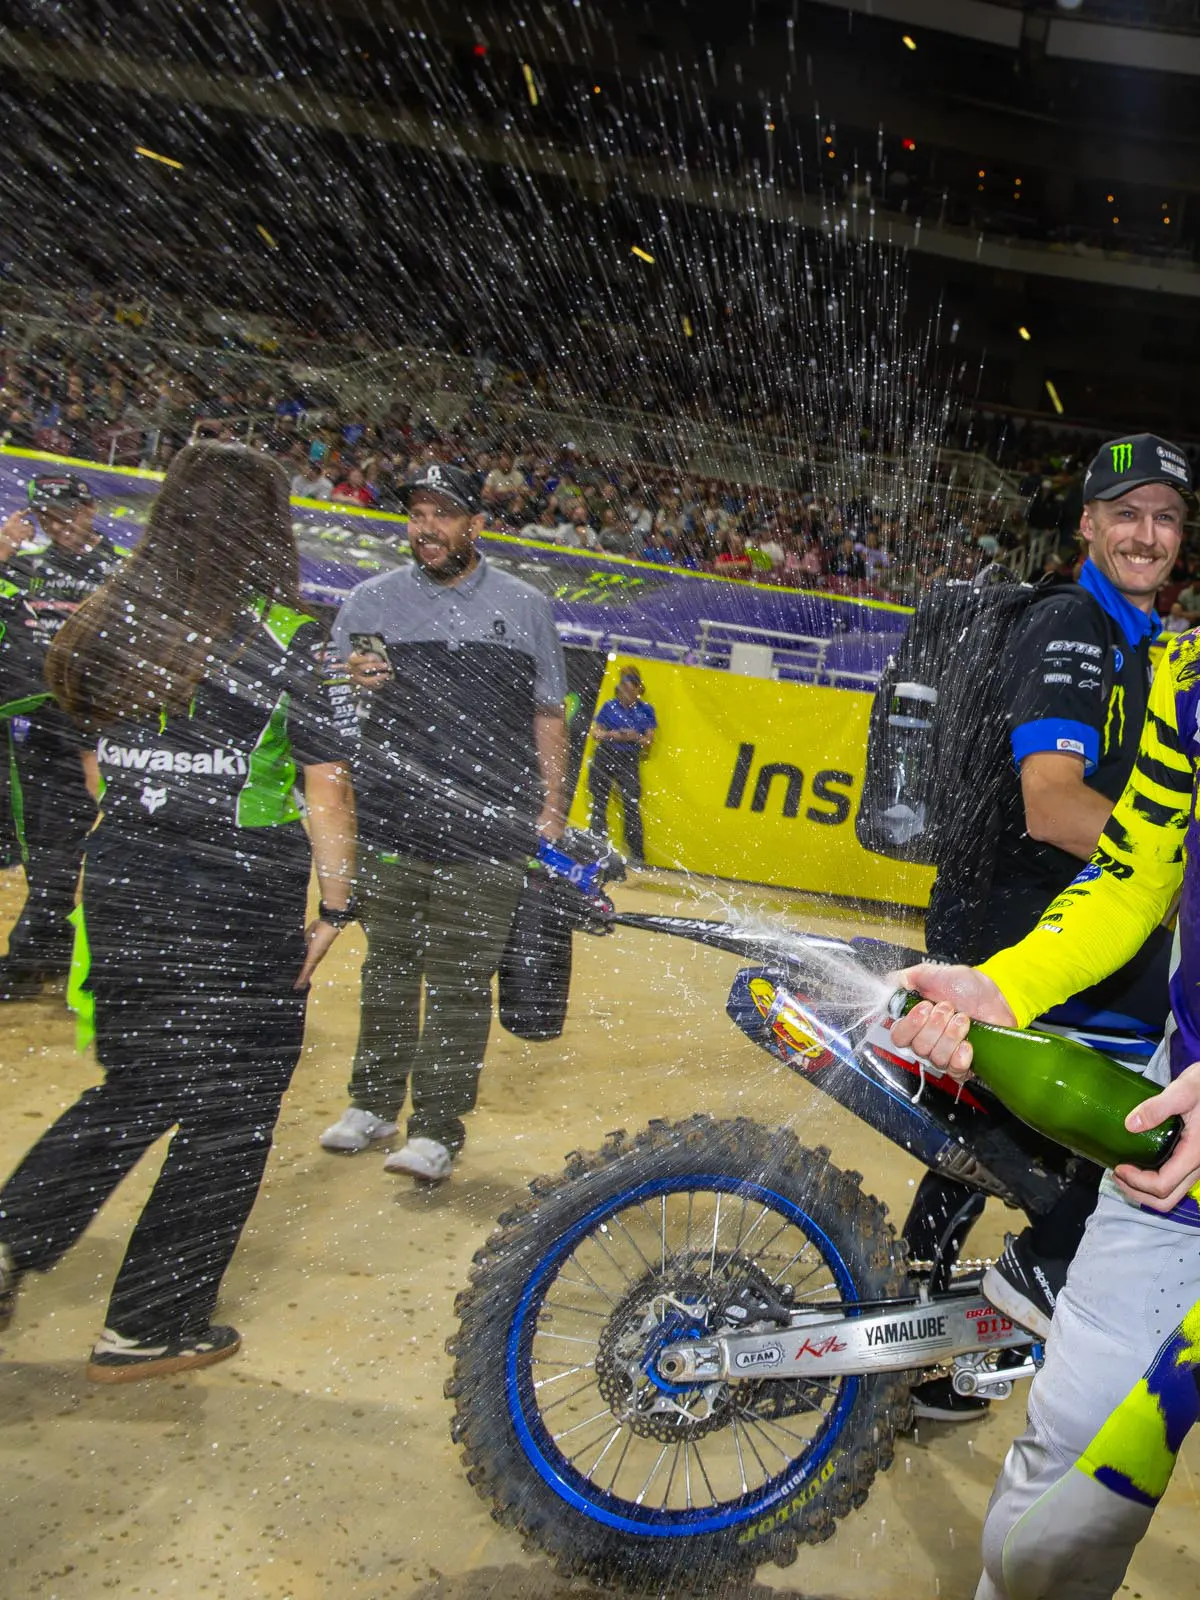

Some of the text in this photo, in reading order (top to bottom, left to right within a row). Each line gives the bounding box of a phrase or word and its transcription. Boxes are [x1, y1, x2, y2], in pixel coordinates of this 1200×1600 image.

[97, 736, 248, 776] Kawasaki
[965, 1304, 997, 1320] BRA
[742, 1351, 774, 1363] AFAM
